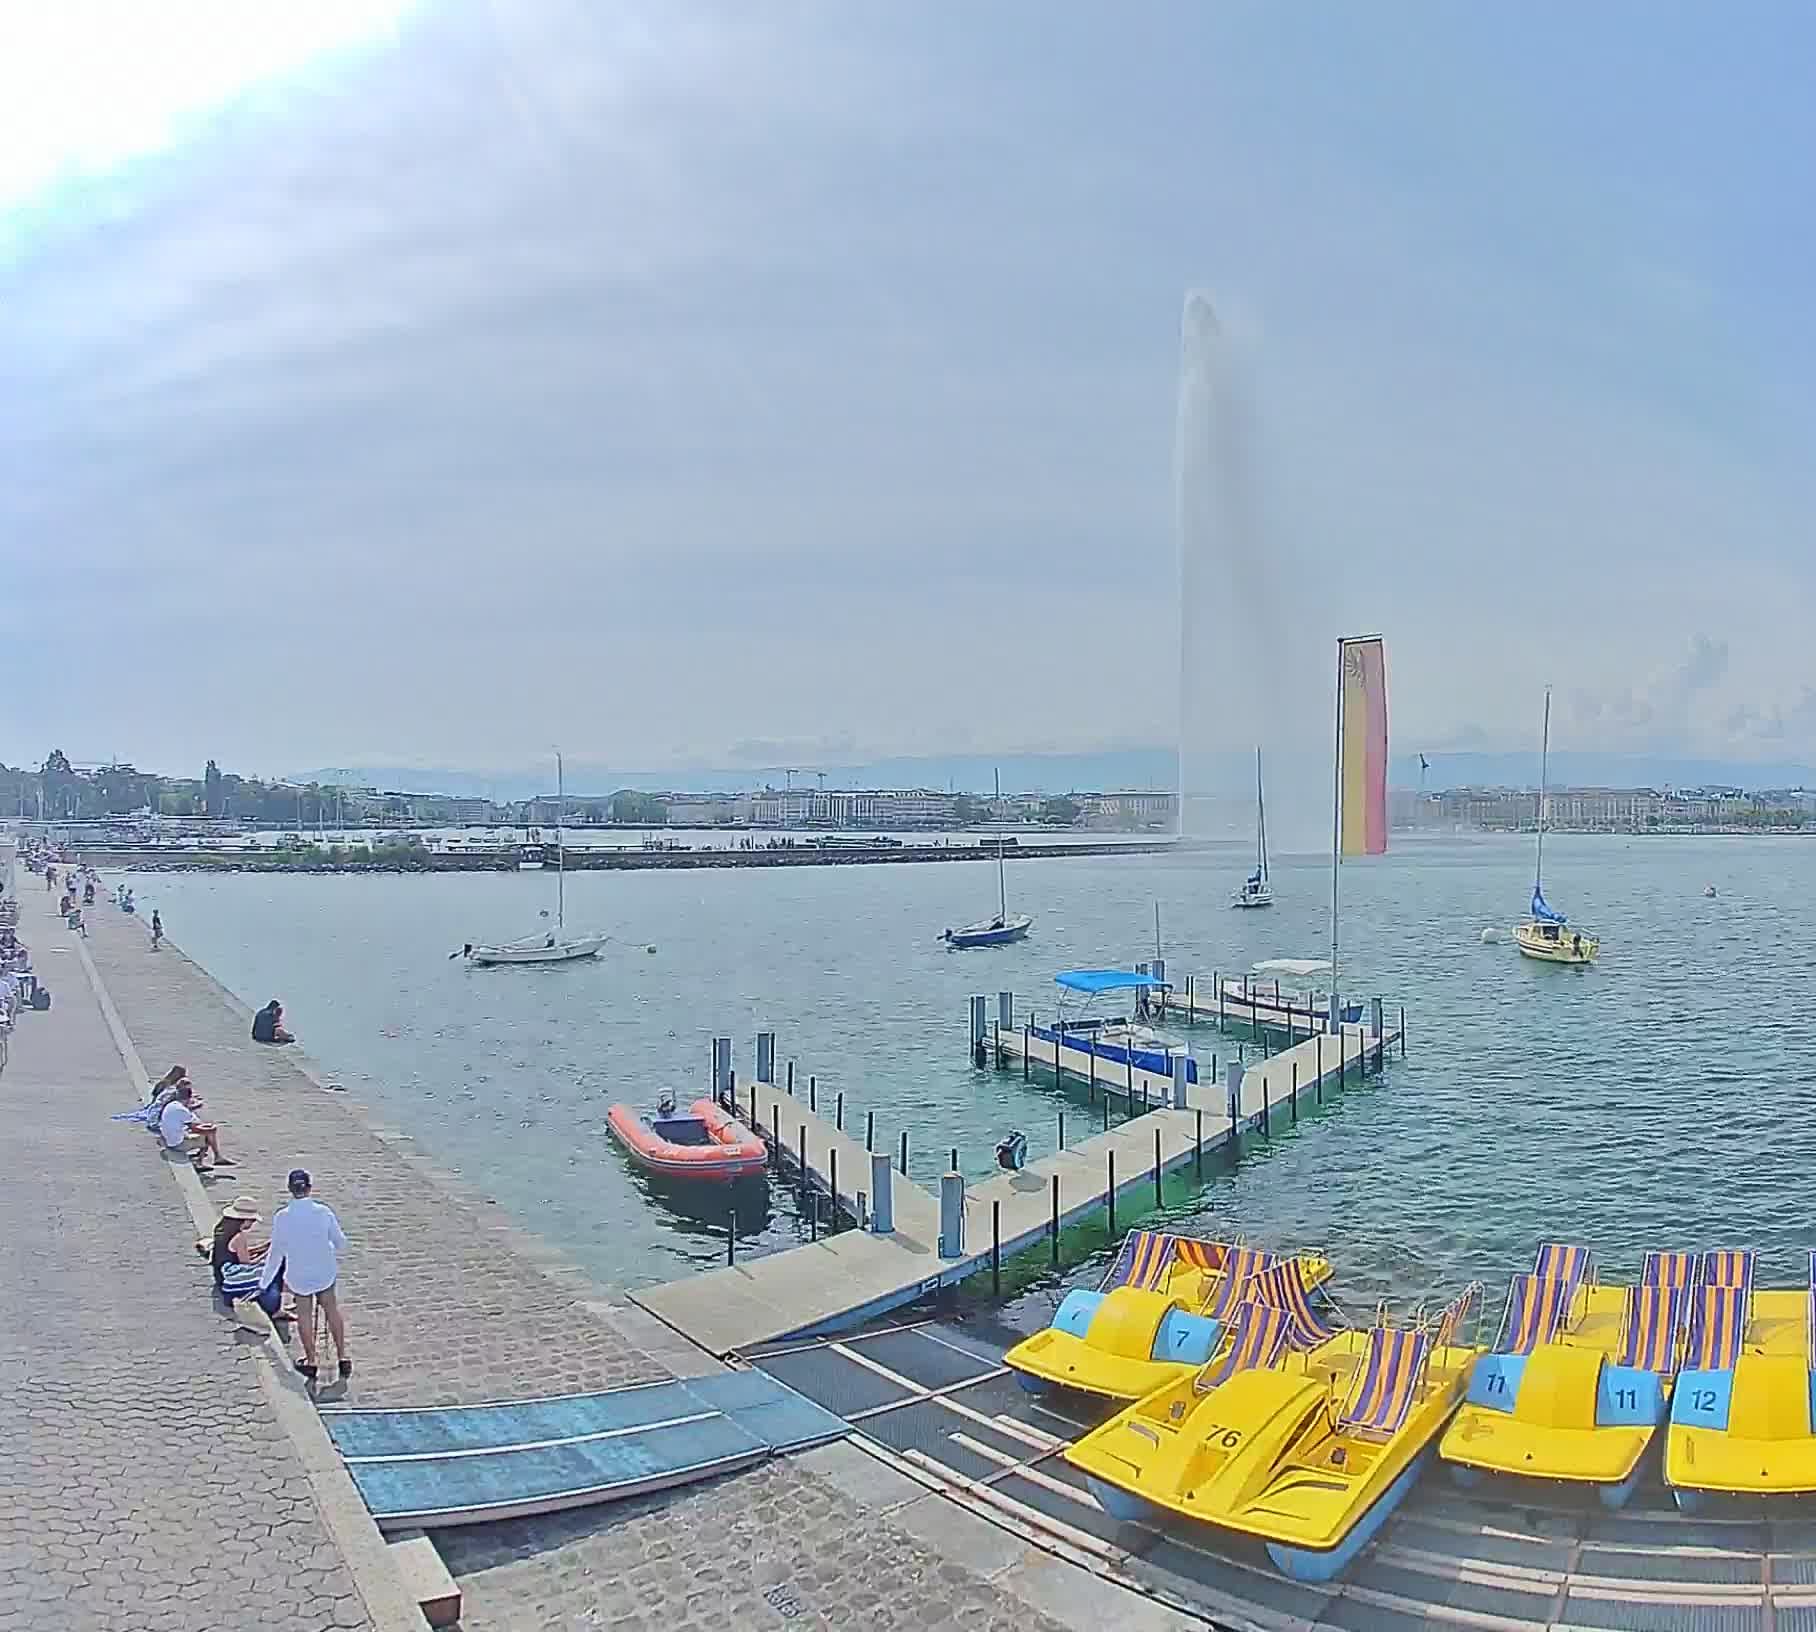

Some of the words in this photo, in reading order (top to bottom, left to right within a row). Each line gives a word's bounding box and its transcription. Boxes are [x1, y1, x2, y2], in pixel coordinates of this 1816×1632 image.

[1176, 1330, 1191, 1347] 7
[1487, 1374, 1506, 1393] 11
[1615, 1389, 1636, 1409] 11
[1692, 1389, 1717, 1412] 12
[1205, 1424, 1242, 1448] 76
